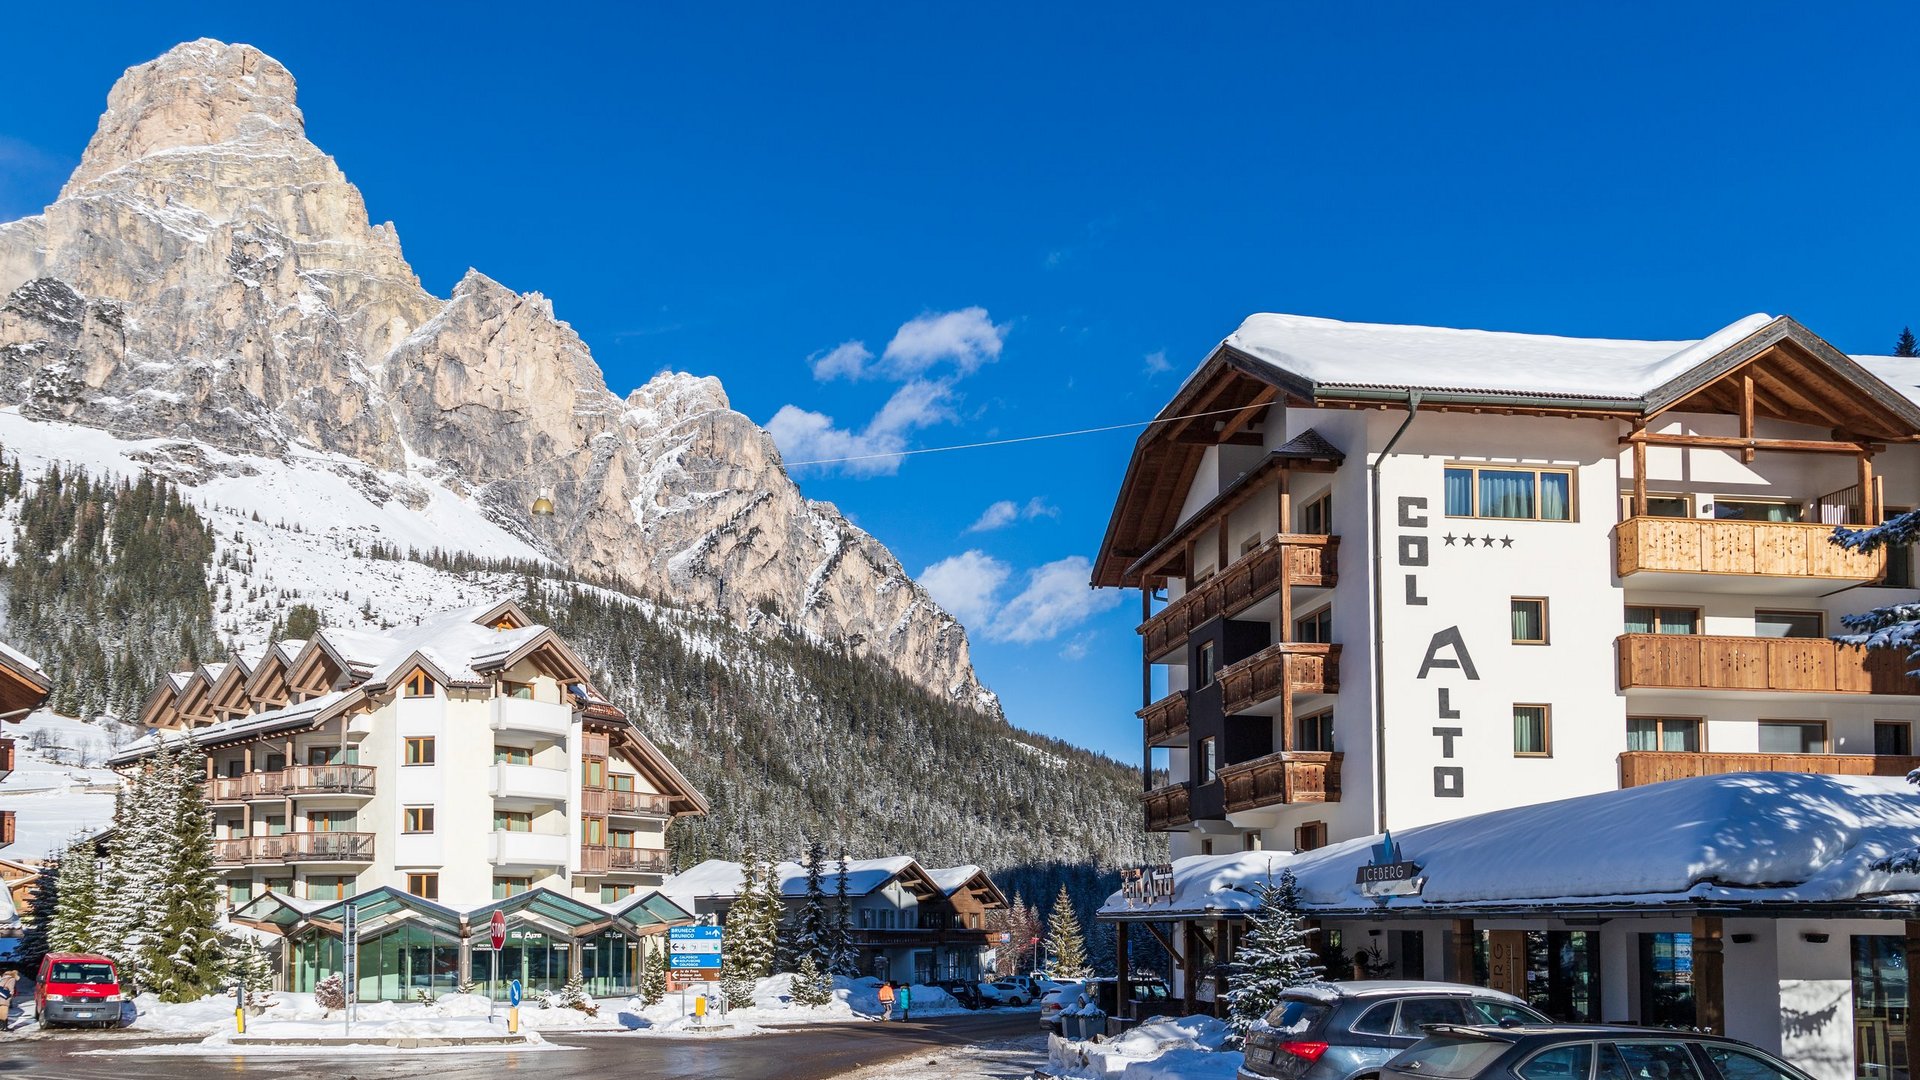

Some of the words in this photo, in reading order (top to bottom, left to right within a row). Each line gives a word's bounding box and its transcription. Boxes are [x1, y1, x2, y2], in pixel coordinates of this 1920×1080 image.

[1398, 496, 1428, 605] COL
[1417, 625, 1480, 797] ALTO
[1363, 865, 1403, 881] ICEBERG
[491, 922, 505, 938] STOP
